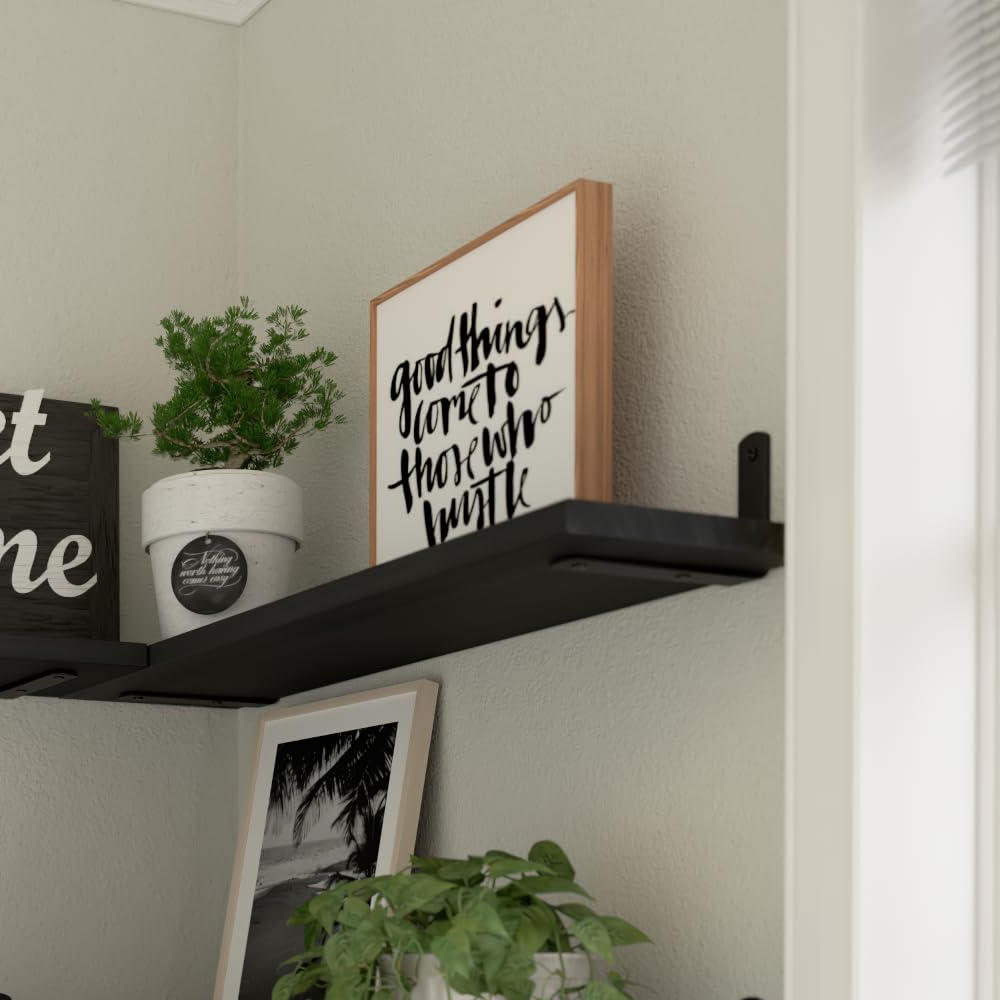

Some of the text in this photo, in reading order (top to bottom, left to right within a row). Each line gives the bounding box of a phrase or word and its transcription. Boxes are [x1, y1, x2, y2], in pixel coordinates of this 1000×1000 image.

[390, 297, 575, 438] good things
[413, 361, 520, 445] come to
[388, 387, 566, 514] those who
[422, 459, 531, 547] hustle
